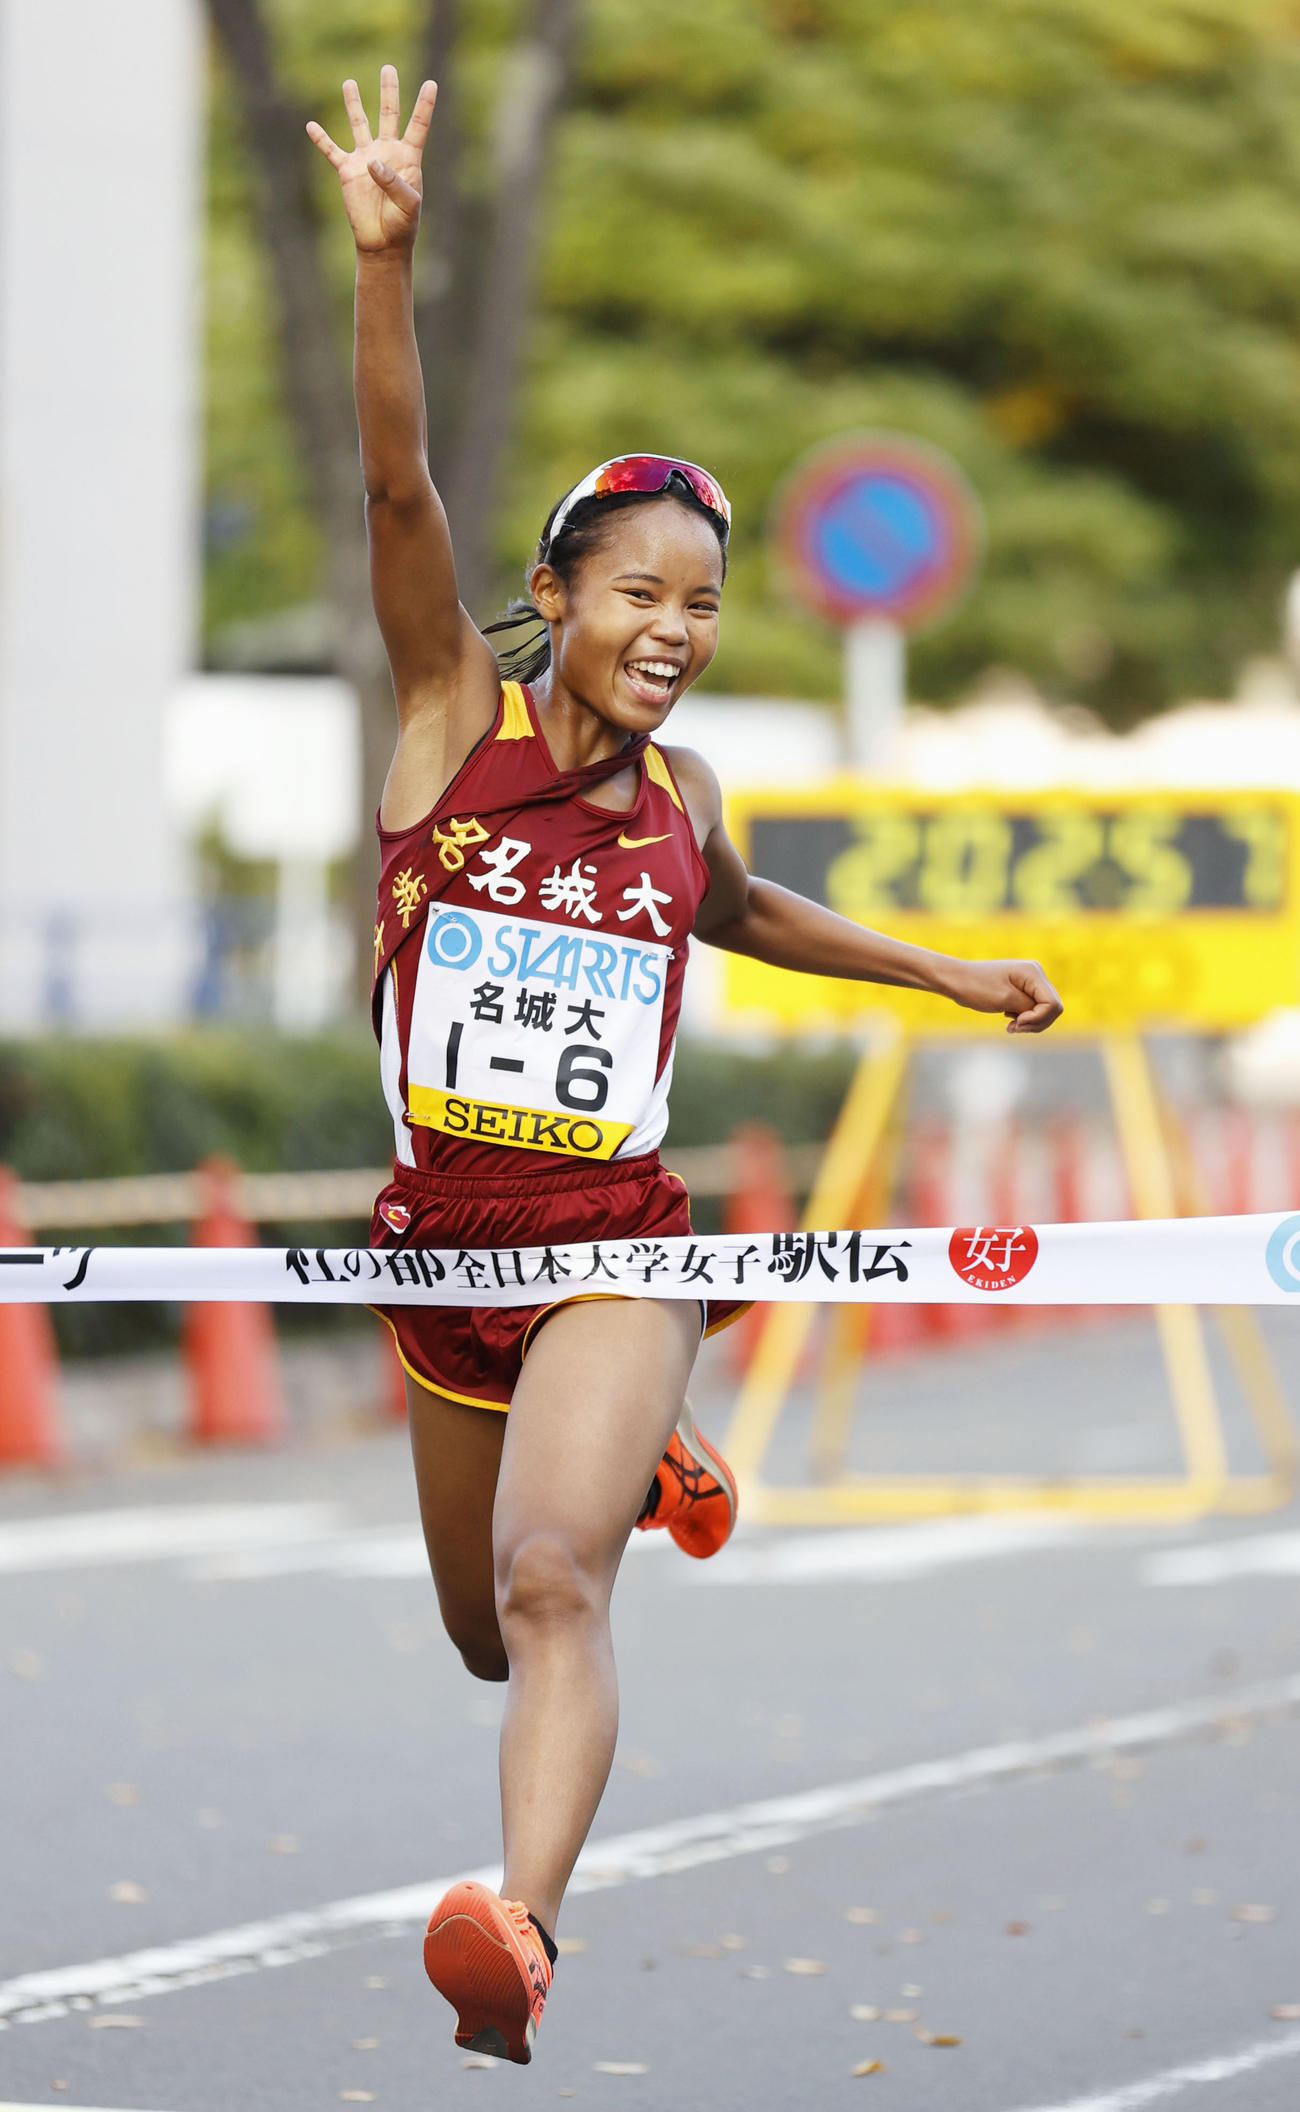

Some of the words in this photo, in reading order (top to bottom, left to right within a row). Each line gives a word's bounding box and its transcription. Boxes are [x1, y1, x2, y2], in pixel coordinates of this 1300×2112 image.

[466, 836, 673, 937] 名城大
[487, 925, 661, 1005] STARTS
[469, 981, 605, 1040] 名城大
[443, 1098, 604, 1152] SEIKO
[967, 1274, 1017, 1289] EKIDEN
